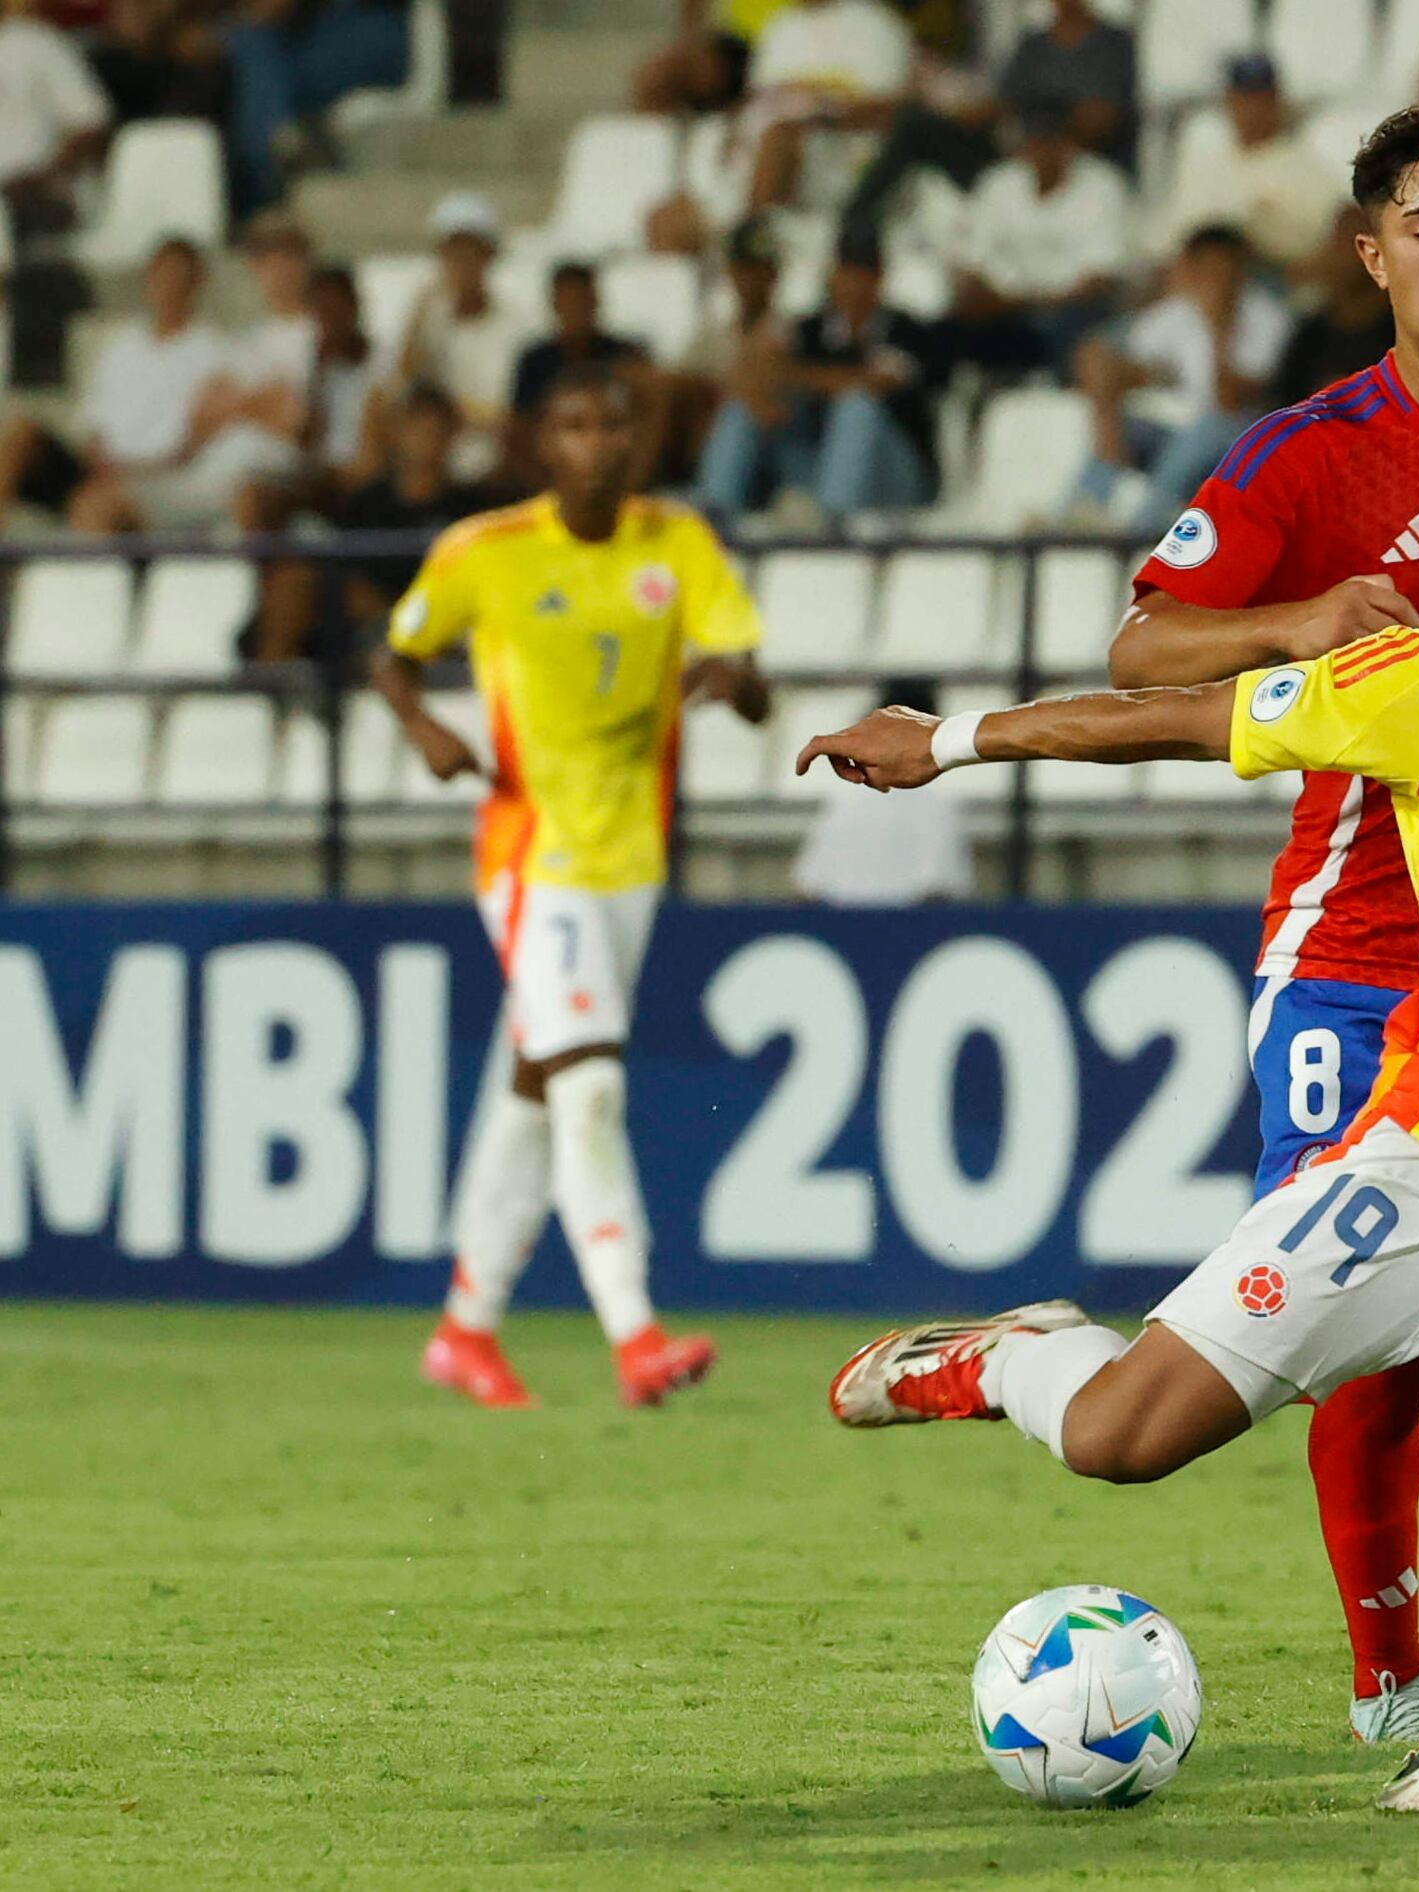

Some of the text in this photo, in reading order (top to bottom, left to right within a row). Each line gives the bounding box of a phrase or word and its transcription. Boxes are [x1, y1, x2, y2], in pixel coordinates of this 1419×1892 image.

[593, 633, 620, 695] 7
[548, 914, 578, 972] 7
[0, 940, 455, 1266] MBI
[1288, 1027, 1342, 1134] 8
[1278, 1173, 1399, 1287] 19
